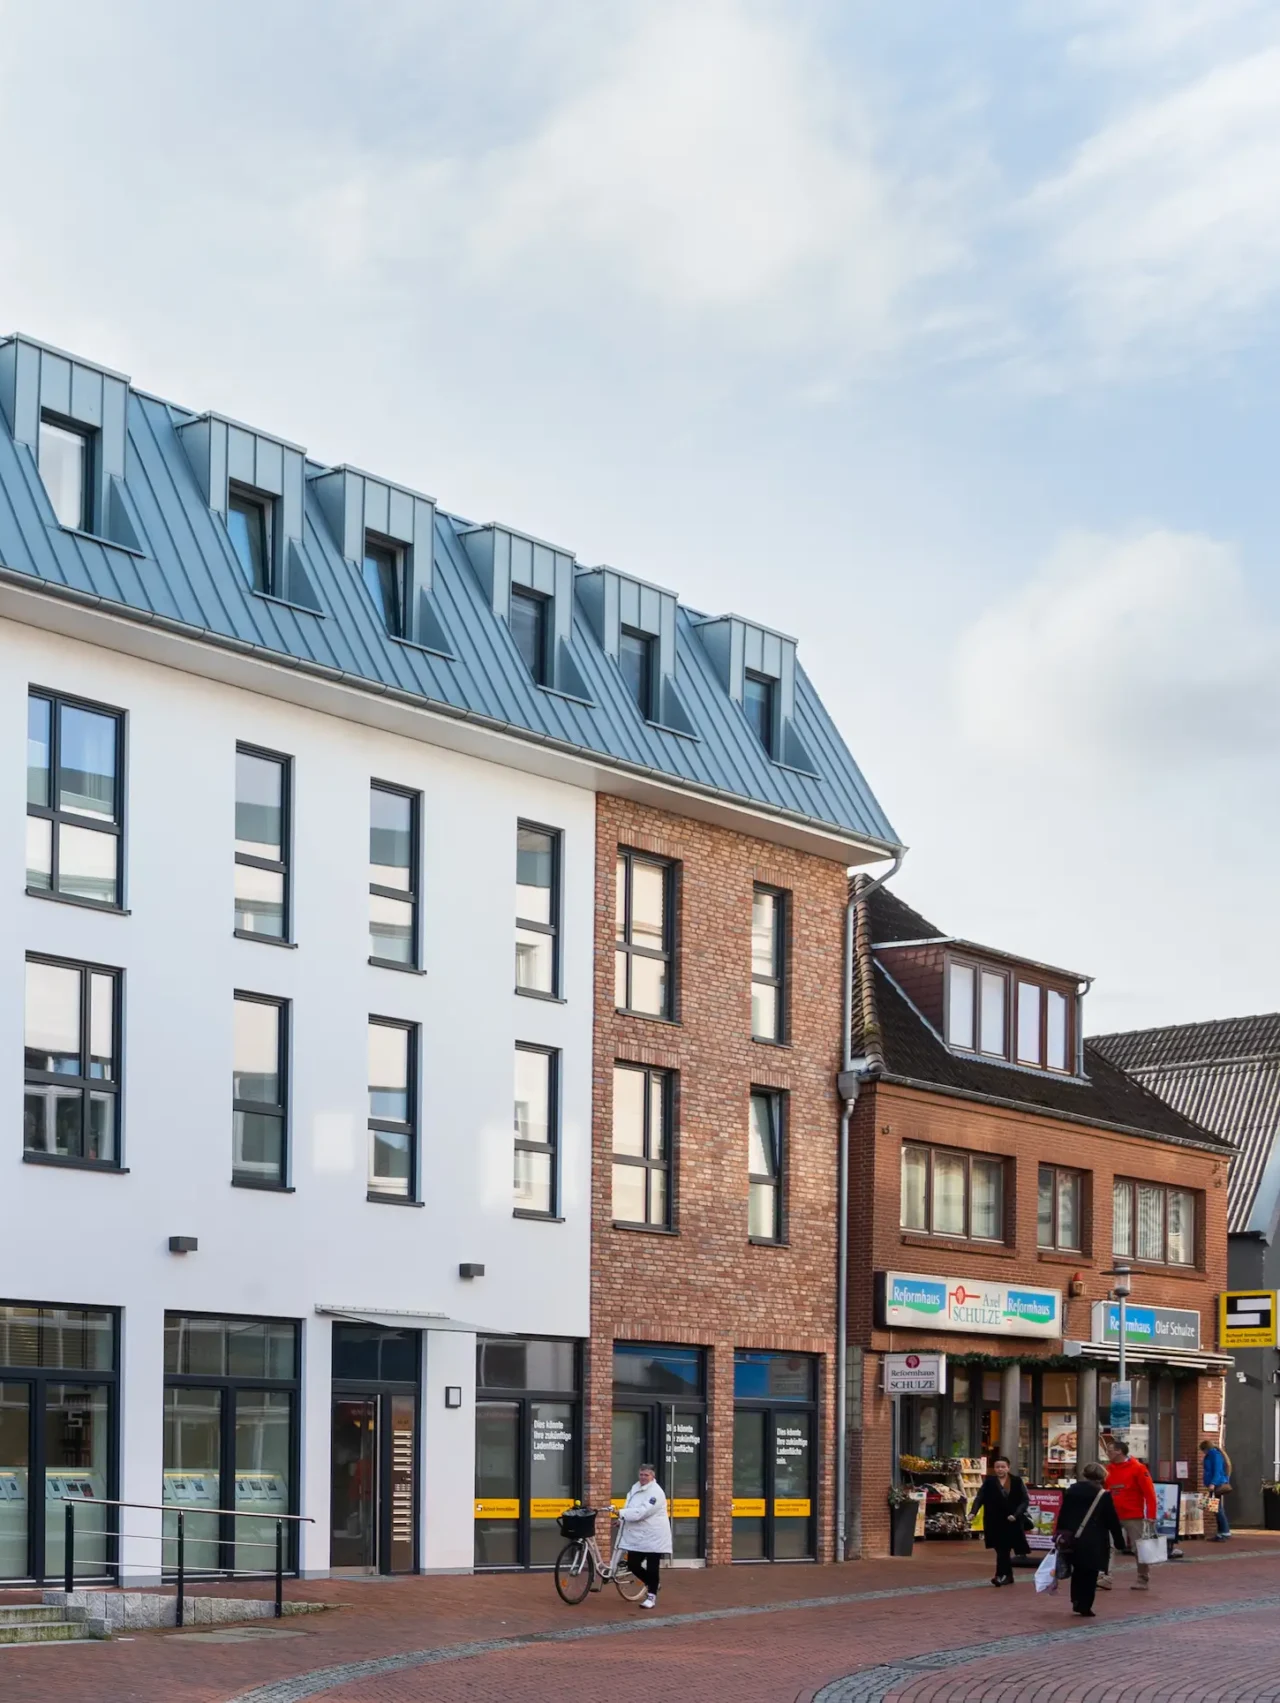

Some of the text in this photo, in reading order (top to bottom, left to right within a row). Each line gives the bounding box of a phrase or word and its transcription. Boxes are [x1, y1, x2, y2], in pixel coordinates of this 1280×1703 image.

[893, 1286, 940, 1307] Reformhaus
[982, 1294, 1001, 1308] Axel
[1008, 1298, 1050, 1316] Reformhaus
[953, 1306, 1001, 1325] SCHULZE
[1109, 1315, 1195, 1338] Rermhaus Olaf Schulze
[891, 1369, 935, 1377] Reformhaus
[890, 1380, 935, 1389] SCHULZE
[534, 1420, 563, 1429] Dies könnte
[666, 1423, 693, 1433] Dis könnte
[533, 1431, 571, 1441] Ihre zukünftige
[776, 1428, 801, 1436] Dies könnte
[676, 1435, 700, 1445] zukünftige
[786, 1438, 808, 1447] zukünftige
[533, 1442, 564, 1450] Ladenfläche
[777, 1447, 801, 1455] Ladenfläche
[533, 1452, 545, 1460] sein.
